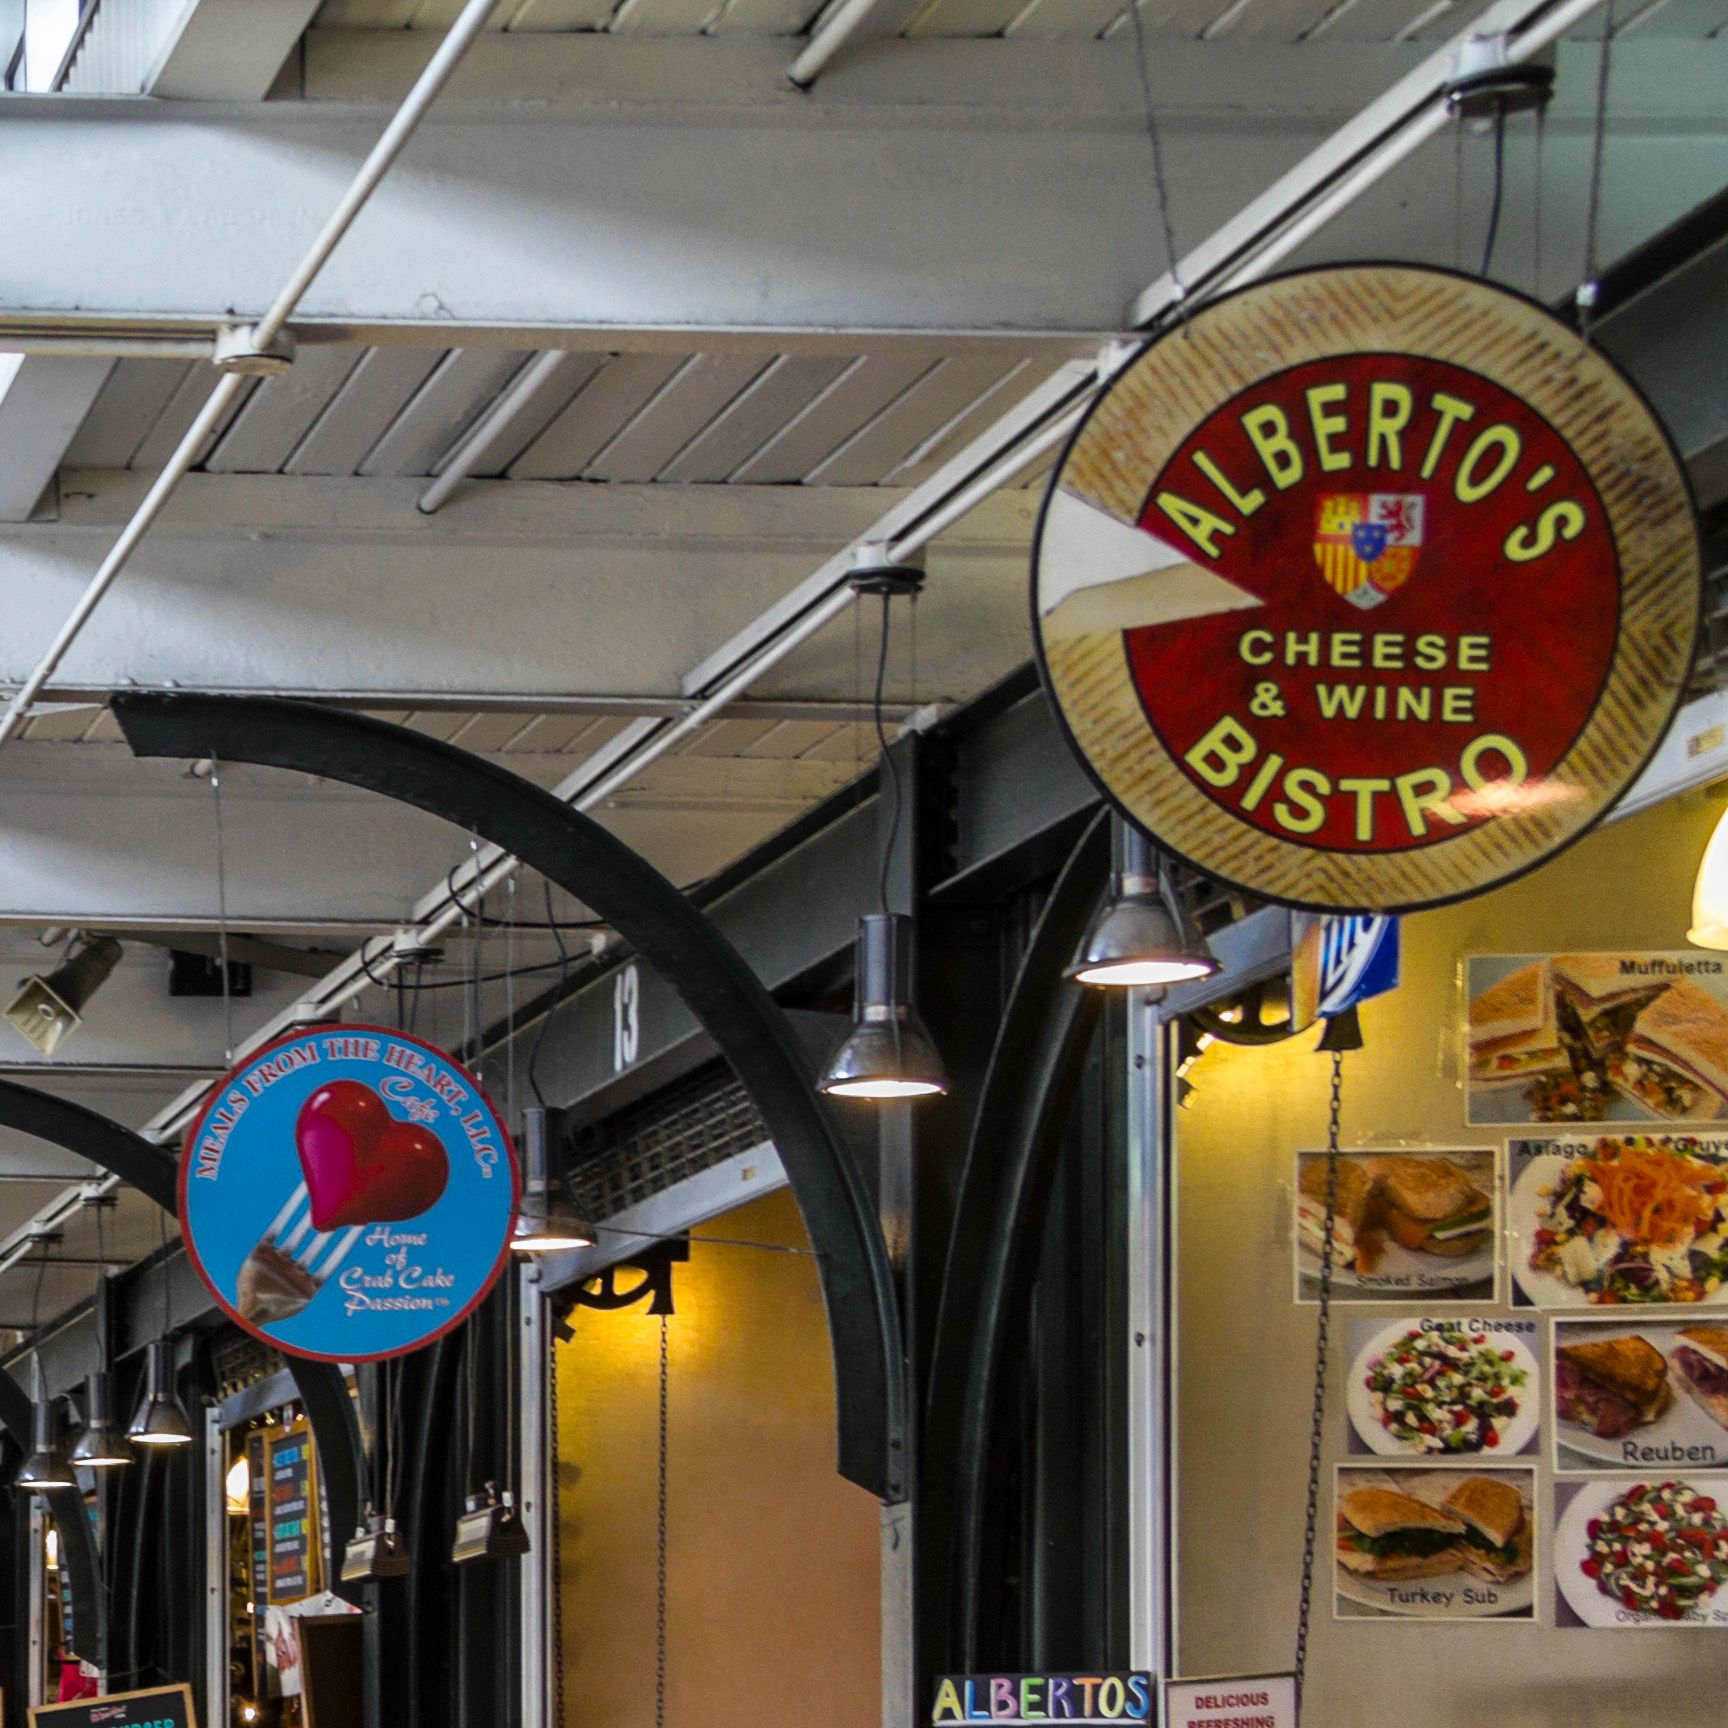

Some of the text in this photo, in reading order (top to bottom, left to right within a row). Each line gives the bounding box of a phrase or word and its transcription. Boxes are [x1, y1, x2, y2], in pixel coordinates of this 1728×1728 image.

[1157, 381, 1586, 562] ALBERTO'S
[1238, 629, 1491, 671] CHEESE
[1248, 683, 1476, 722] & WINE
[1184, 715, 1530, 843] BISTRO
[1619, 959, 1722, 975] Muffuletta
[196, 1090, 249, 1181] MEALS
[243, 1043, 320, 1096] FROM
[323, 1037, 380, 1061] THE
[384, 1044, 468, 1115] HEART,
[1519, 1141, 1589, 1159] Asiago
[365, 1228, 427, 1246] Home
[384, 1247, 407, 1270] of
[339, 1267, 455, 1289] Crab Cake
[1420, 1317, 1536, 1333] Goat Cheese
[1623, 1440, 1715, 1463] Reuben
[1388, 1587, 1498, 1608] Turkey Sub
[933, 1676, 1150, 1721] ALBERTOS
[1194, 1692, 1269, 1710] DELICIOUS
